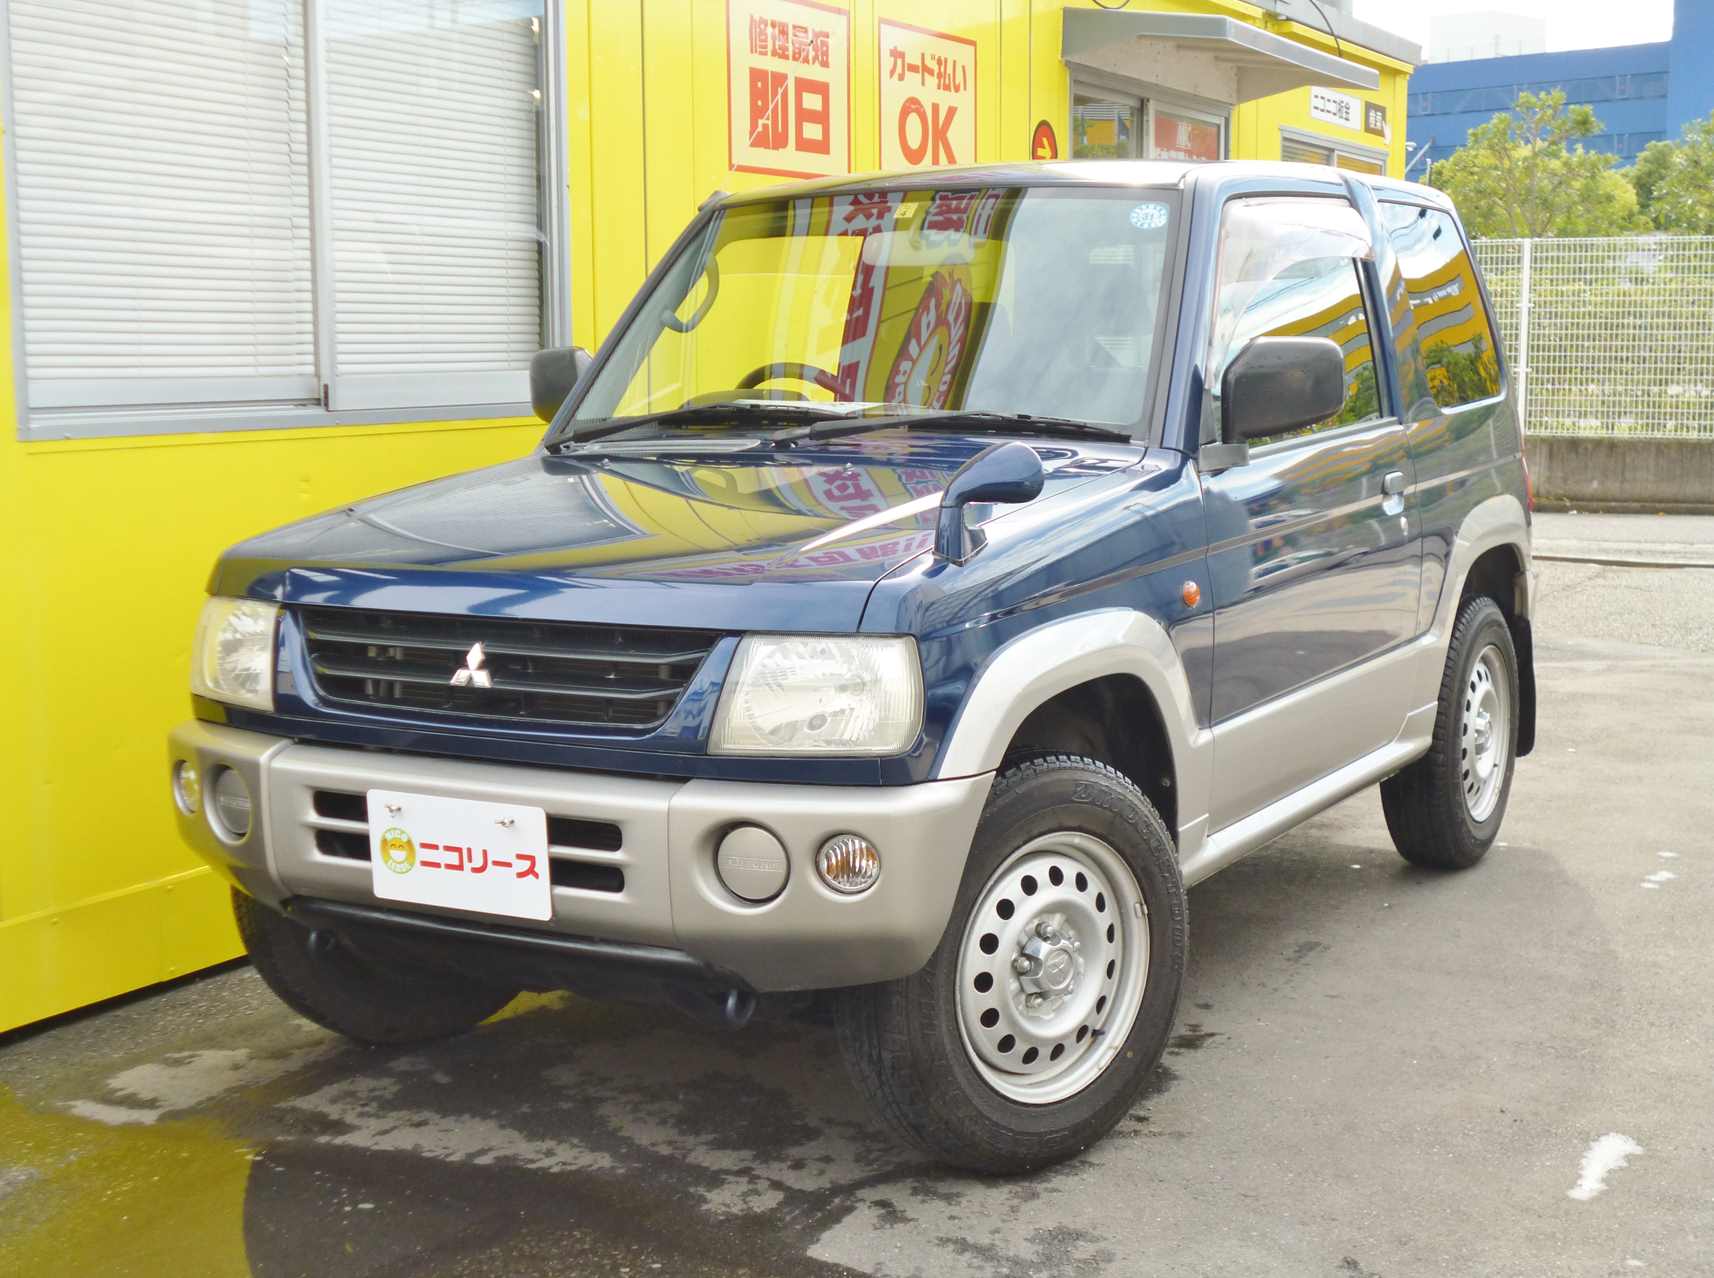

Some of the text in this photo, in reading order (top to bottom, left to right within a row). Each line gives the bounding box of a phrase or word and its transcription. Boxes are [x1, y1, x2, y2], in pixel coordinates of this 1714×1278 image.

[749, 14, 830, 69] 修理最短
[889, 45, 968, 94] カード払い
[748, 66, 830, 155] 即日
[898, 96, 959, 166] OK
[419, 841, 540, 880] ニコリース
